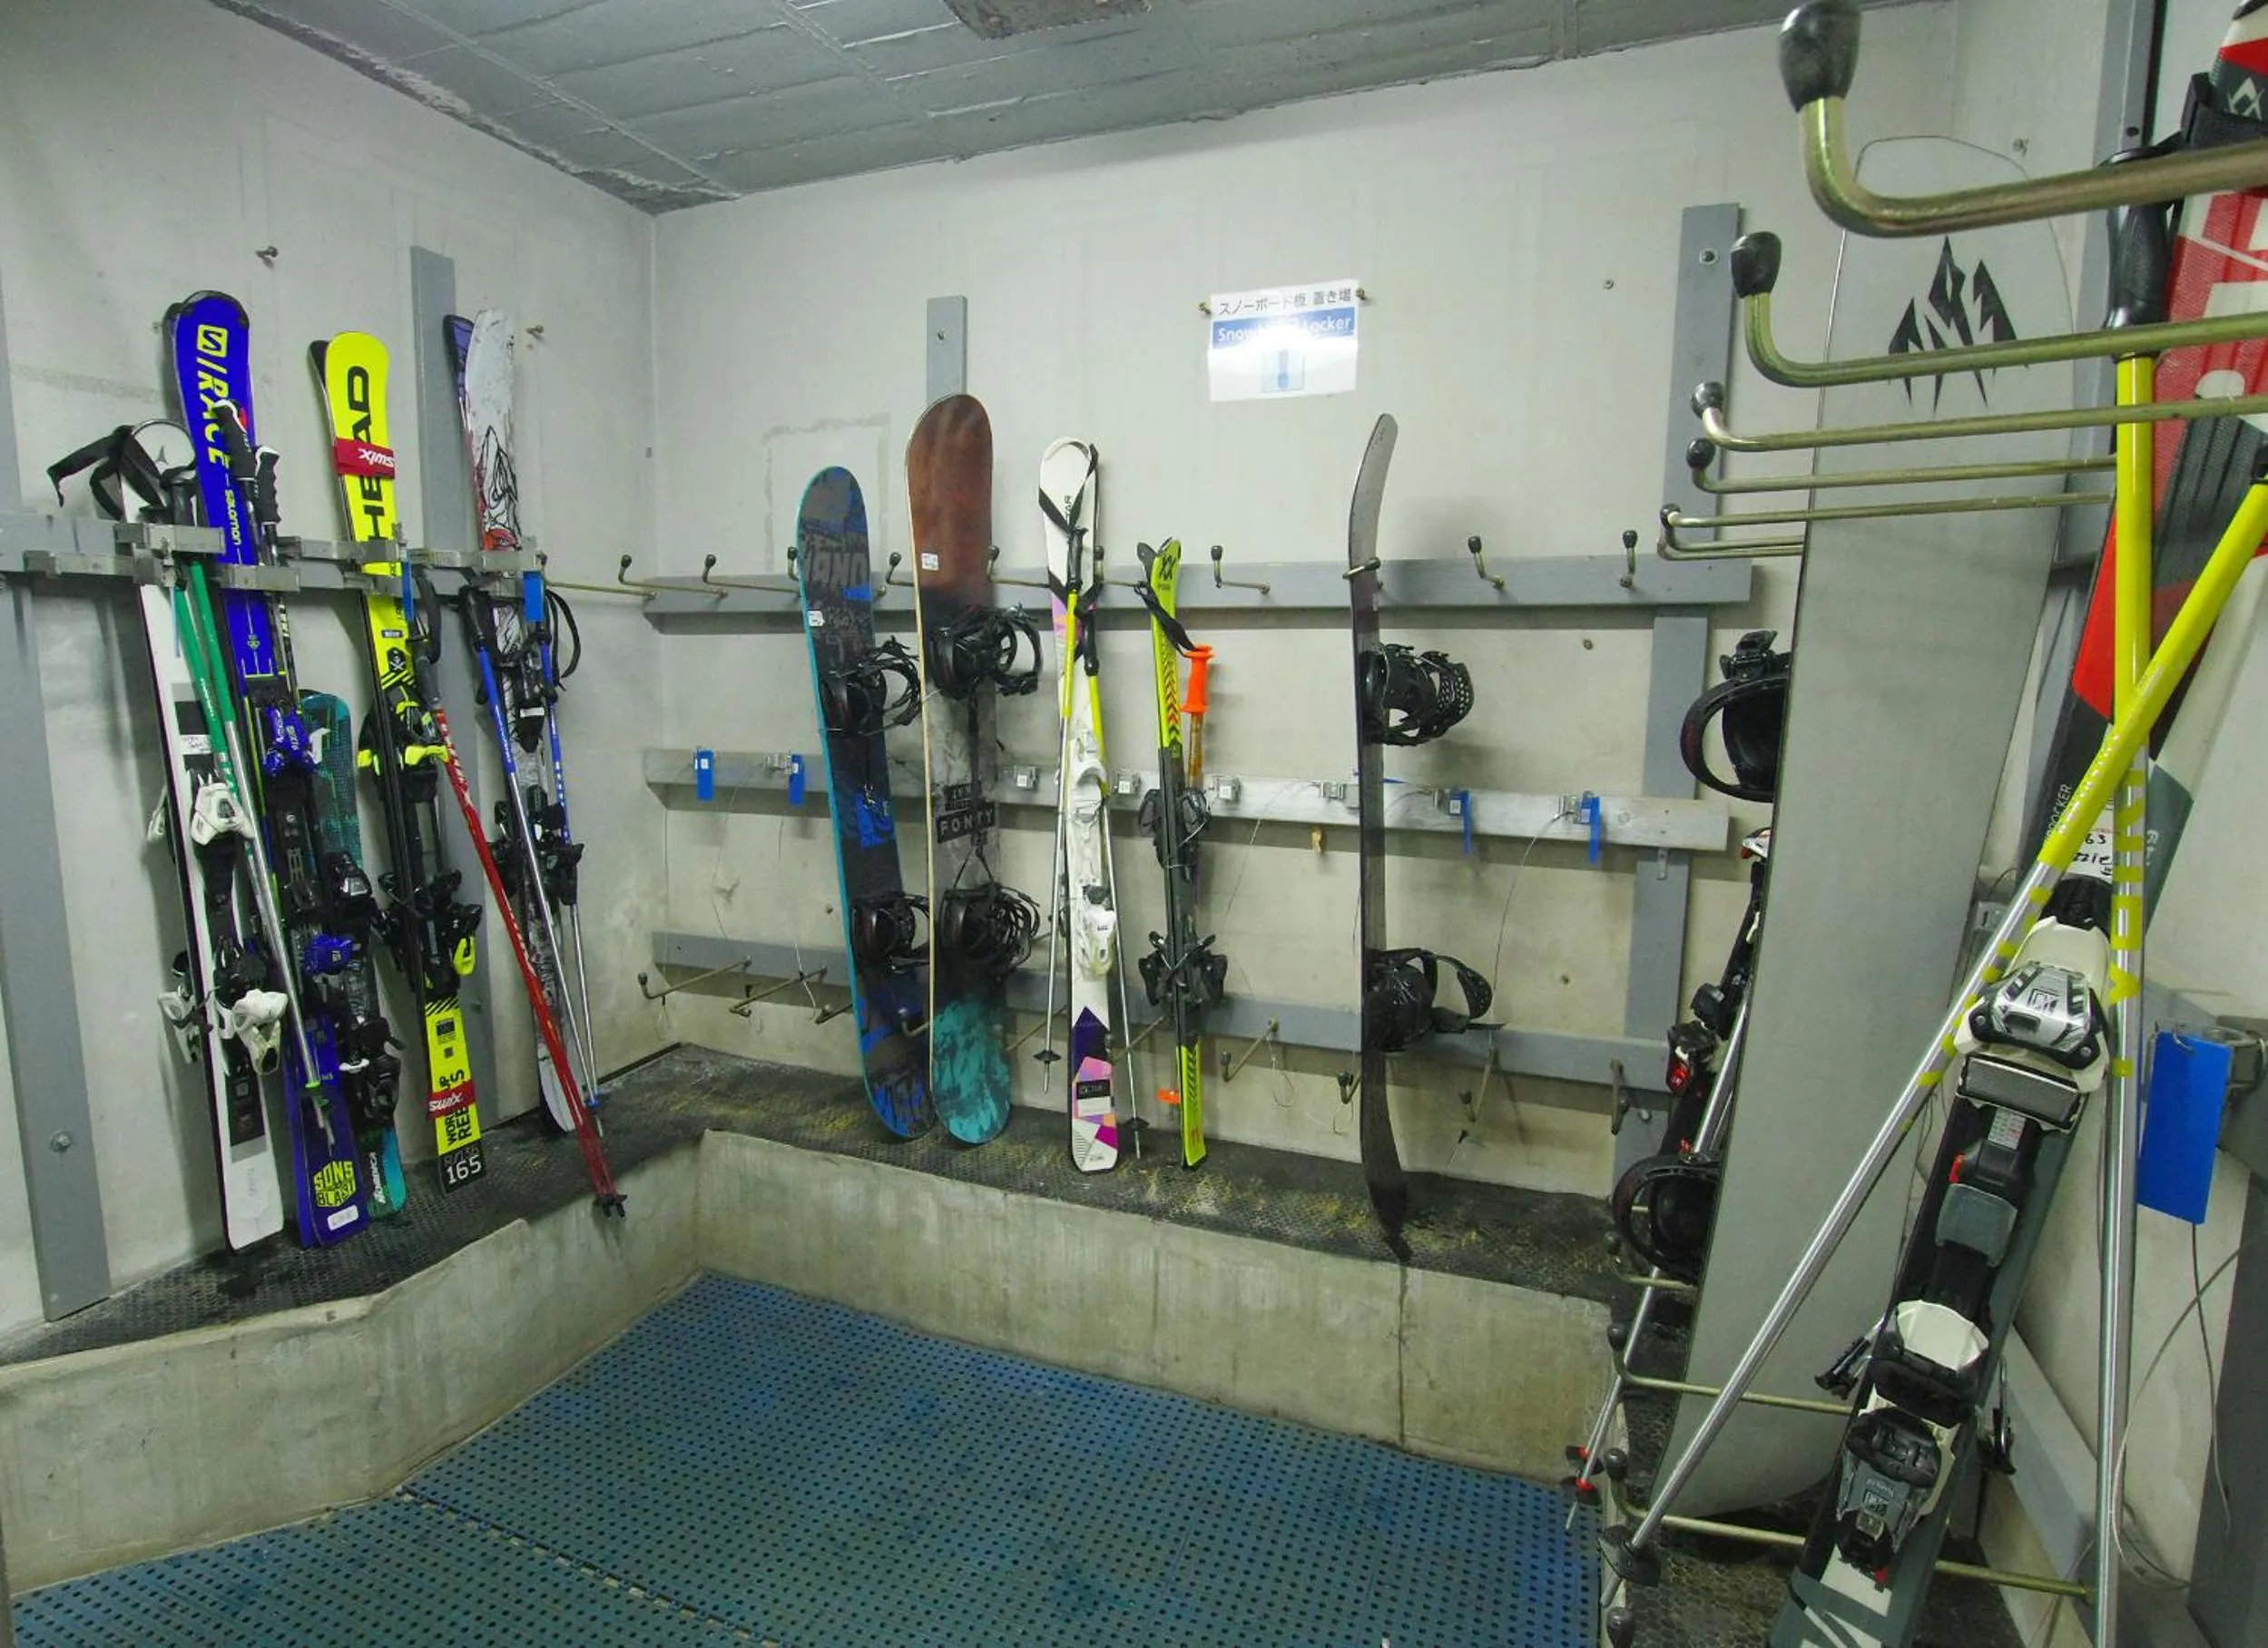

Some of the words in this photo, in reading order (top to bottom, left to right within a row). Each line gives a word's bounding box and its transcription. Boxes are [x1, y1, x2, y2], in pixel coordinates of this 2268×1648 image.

[1313, 288, 1351, 305] 置き場
[313, 1161, 354, 1192] SONS
[446, 1154, 482, 1184] 165
